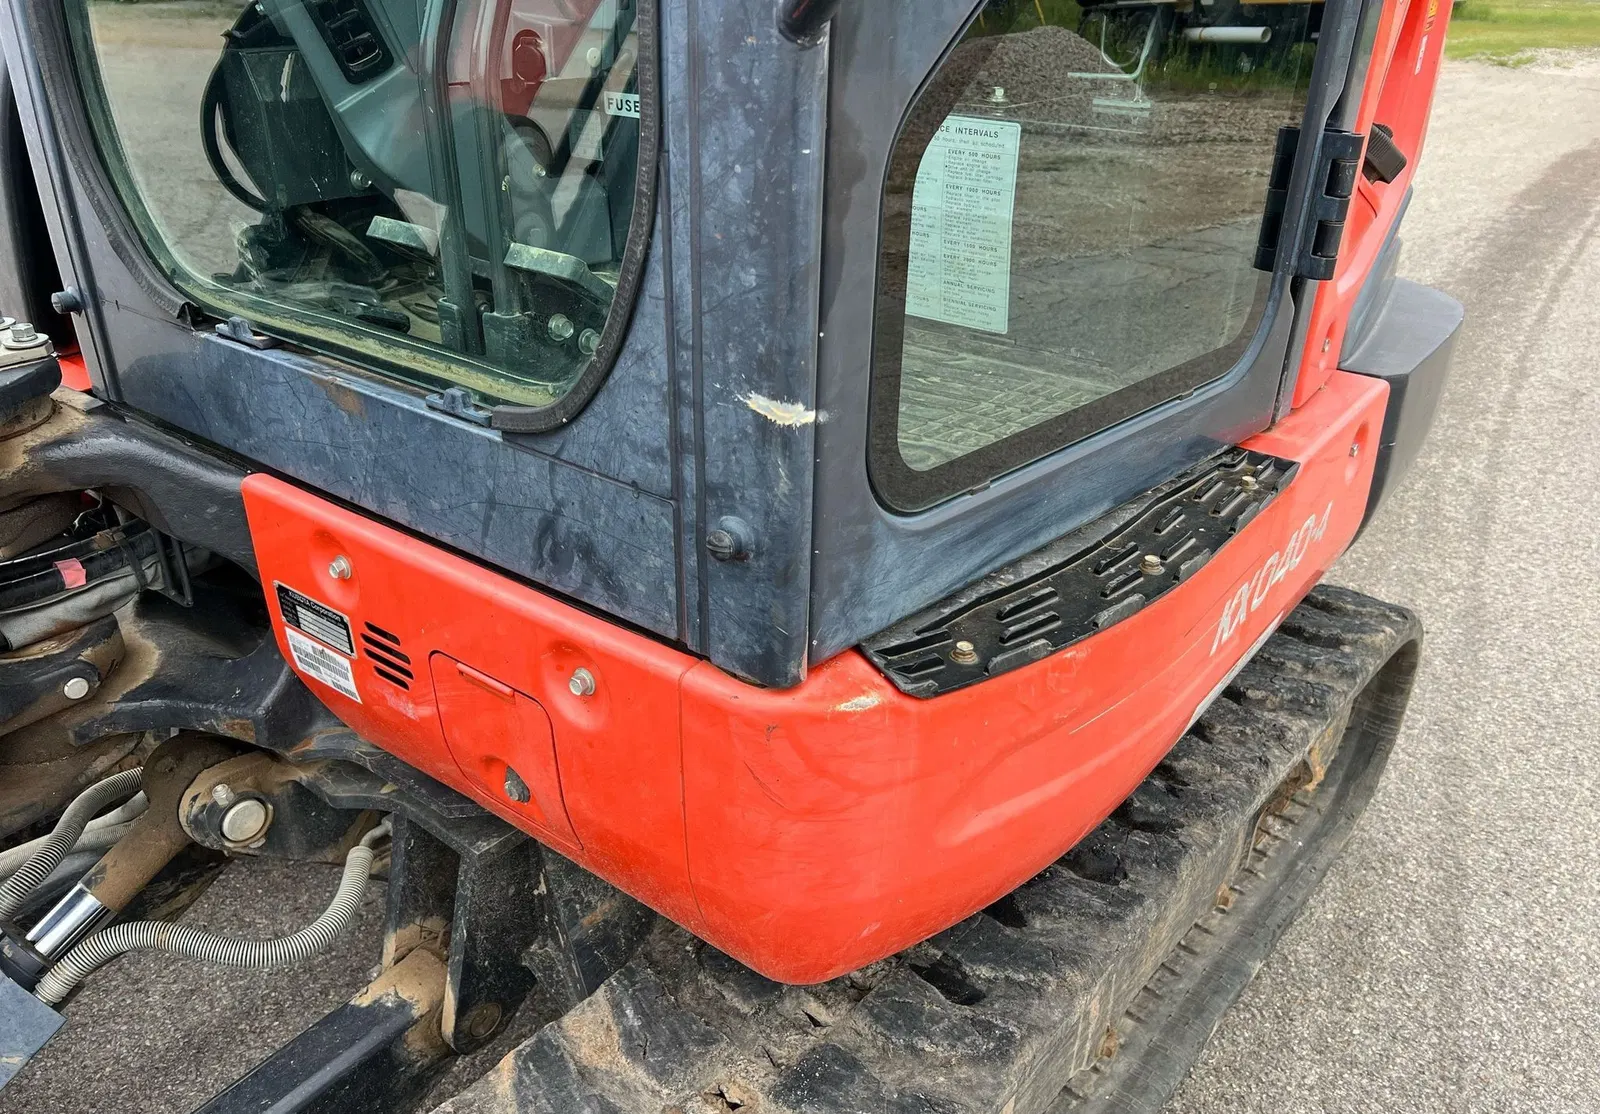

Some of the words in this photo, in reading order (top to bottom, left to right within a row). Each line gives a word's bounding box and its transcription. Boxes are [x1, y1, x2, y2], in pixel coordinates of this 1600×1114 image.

[608, 98, 640, 113] FUSE
[955, 127, 999, 139] INTERVALS
[948, 148, 966, 156] EVERY
[945, 183, 963, 191] EVERY
[981, 188, 1001, 196] HOURS
[943, 280, 964, 288] ANNUAL
[966, 284, 996, 294] SERVICING
[943, 297, 967, 306] BIENNIAL
[968, 302, 997, 312] SERVICING
[288, 590, 311, 607] KUBOTA
